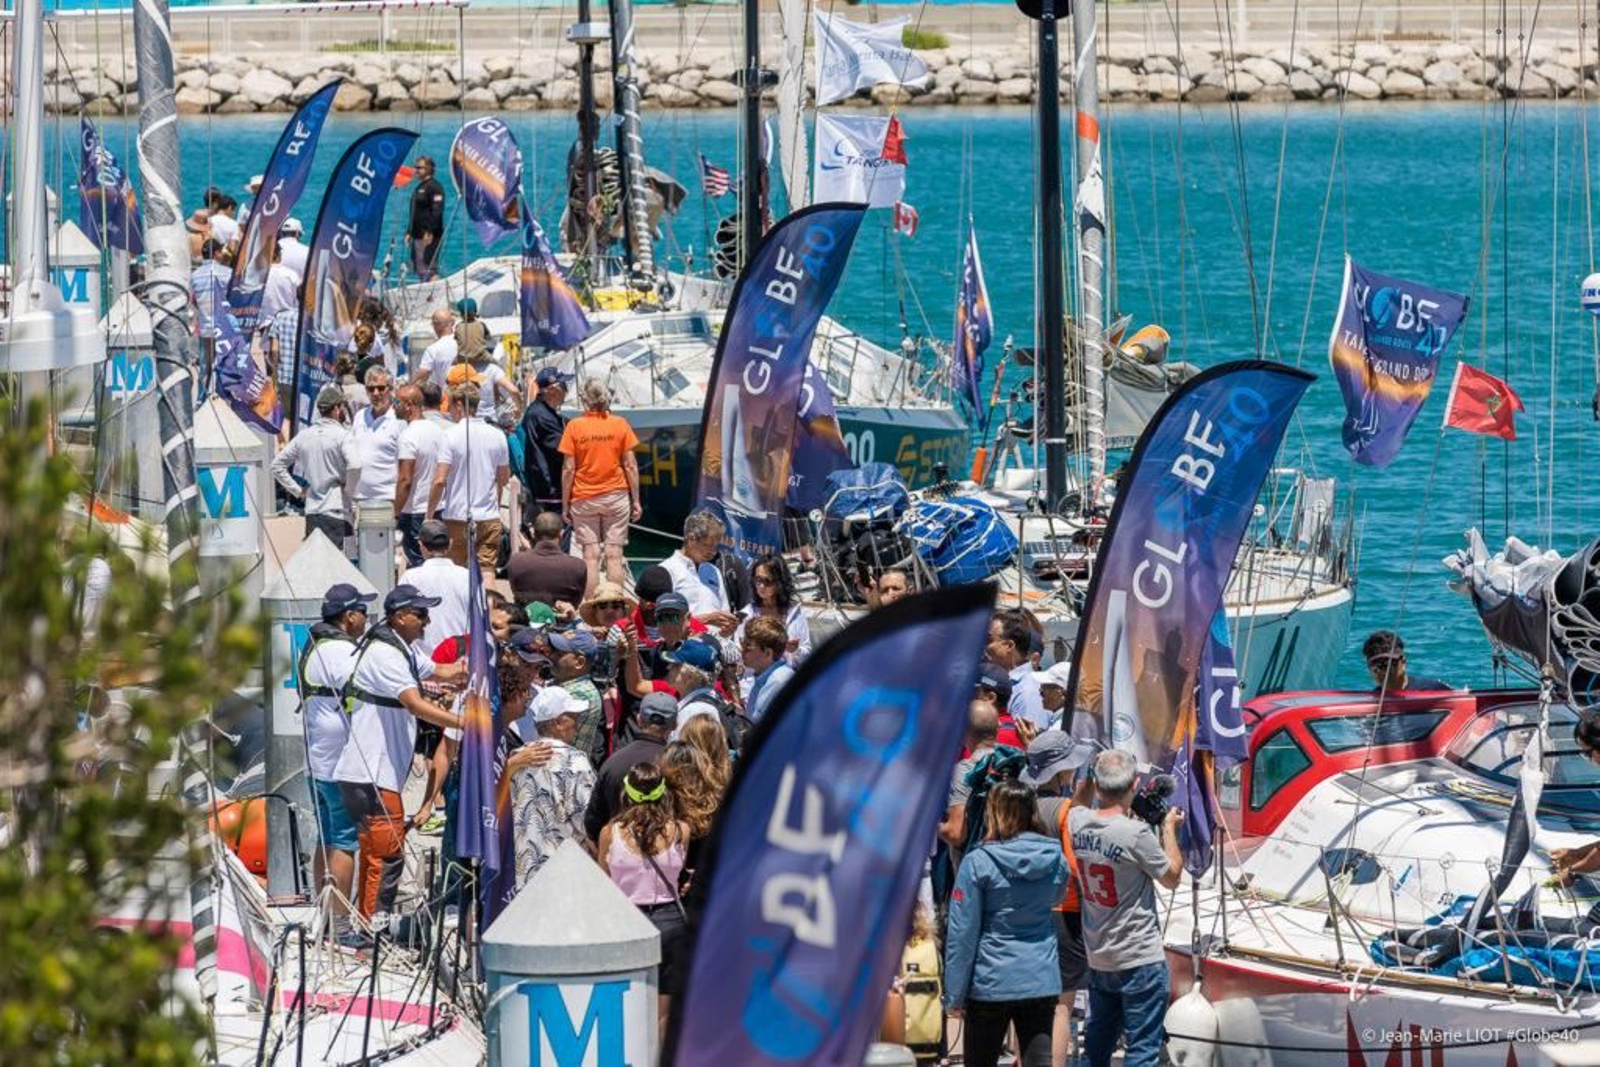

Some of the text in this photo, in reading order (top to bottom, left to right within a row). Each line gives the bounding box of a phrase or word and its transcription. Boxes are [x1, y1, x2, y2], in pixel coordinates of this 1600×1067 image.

[111, 352, 154, 392] M
[1077, 857, 1119, 909] 13
[516, 979, 632, 1067] M
